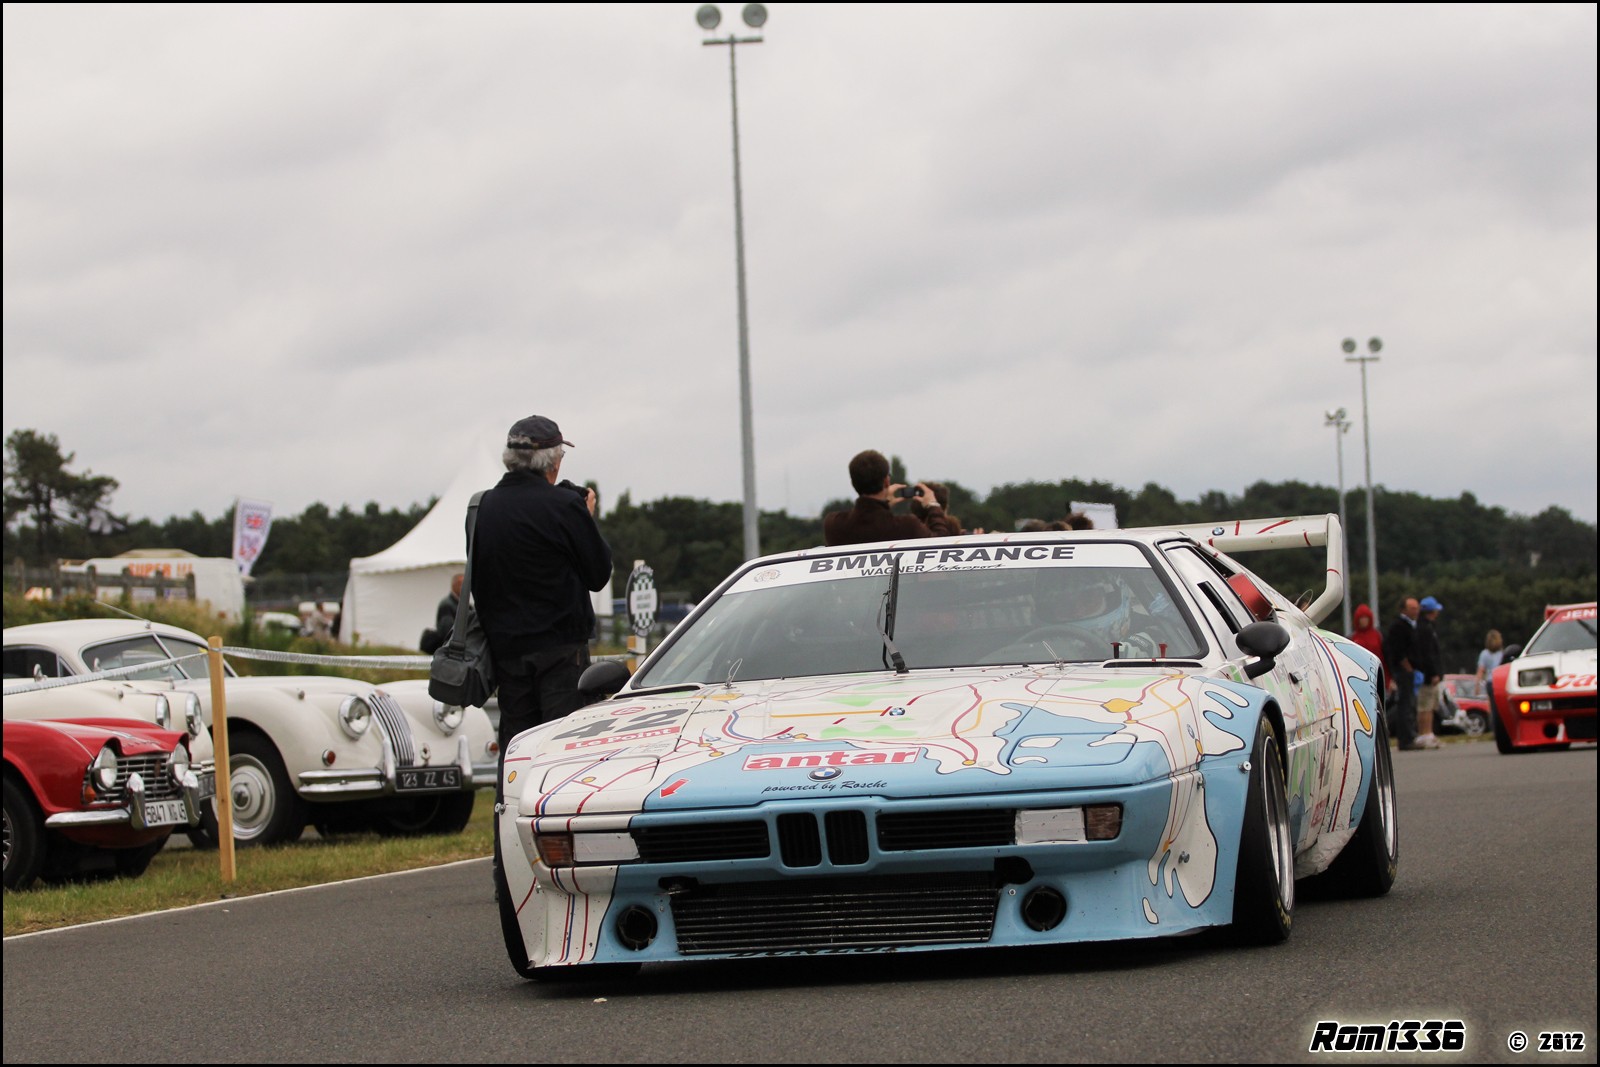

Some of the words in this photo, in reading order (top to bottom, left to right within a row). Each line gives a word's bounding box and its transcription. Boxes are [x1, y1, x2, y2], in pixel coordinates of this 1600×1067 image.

[809, 552, 904, 573] BMW
[915, 546, 1075, 564] FRANCE
[861, 565, 925, 577] WAGNER
[551, 708, 689, 741] 42
[607, 728, 672, 743] Point
[746, 751, 917, 769] antar
[402, 772, 418, 787] 123
[424, 771, 437, 786] ZZ
[442, 770, 455, 785] 45
[761, 783, 818, 794] powered
[821, 782, 837, 792] by
[840, 779, 888, 790] Rosche
[146, 803, 167, 824] 5847
